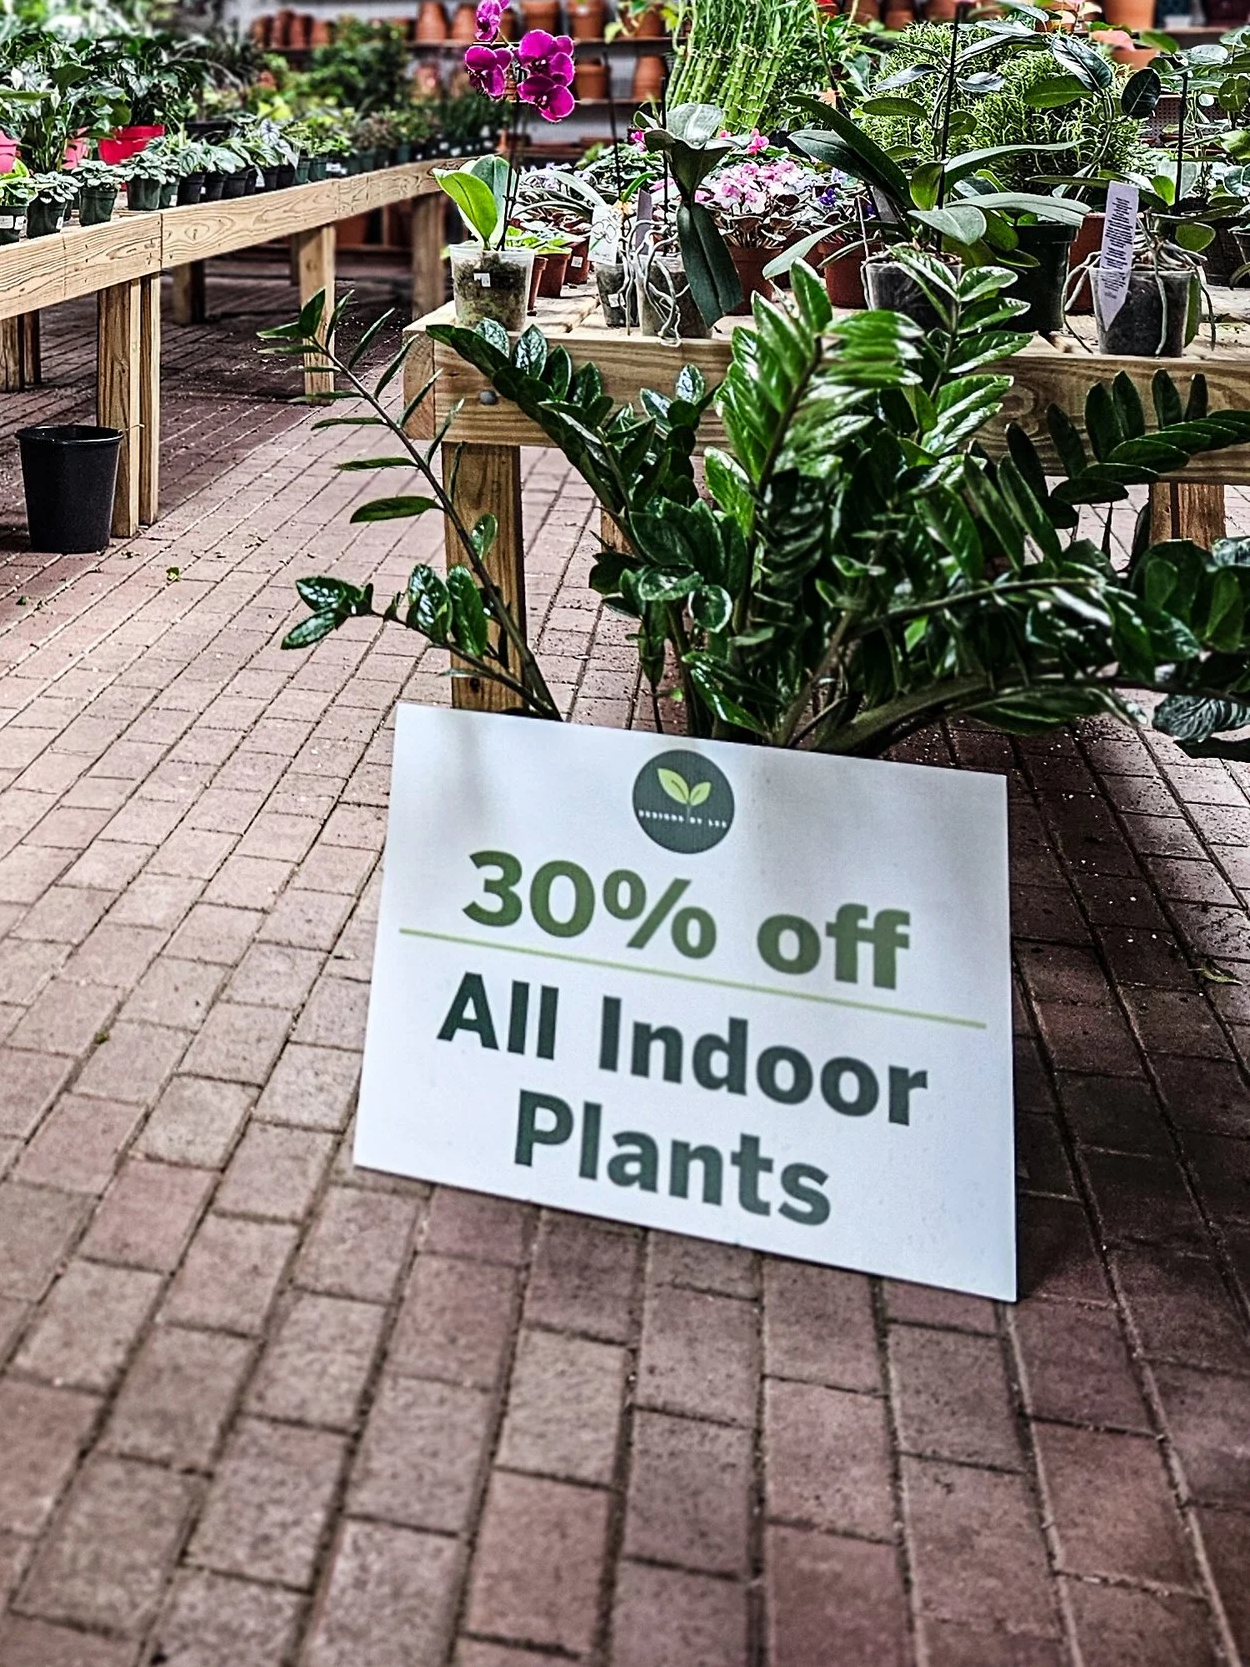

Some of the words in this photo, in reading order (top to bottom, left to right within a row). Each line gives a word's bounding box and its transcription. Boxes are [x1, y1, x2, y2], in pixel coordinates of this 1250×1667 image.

[462, 850, 716, 959] 30%
[757, 903, 910, 990] off
[437, 972, 559, 1060] All
[599, 996, 928, 1126] Indoor
[515, 1089, 830, 1225] Plants
